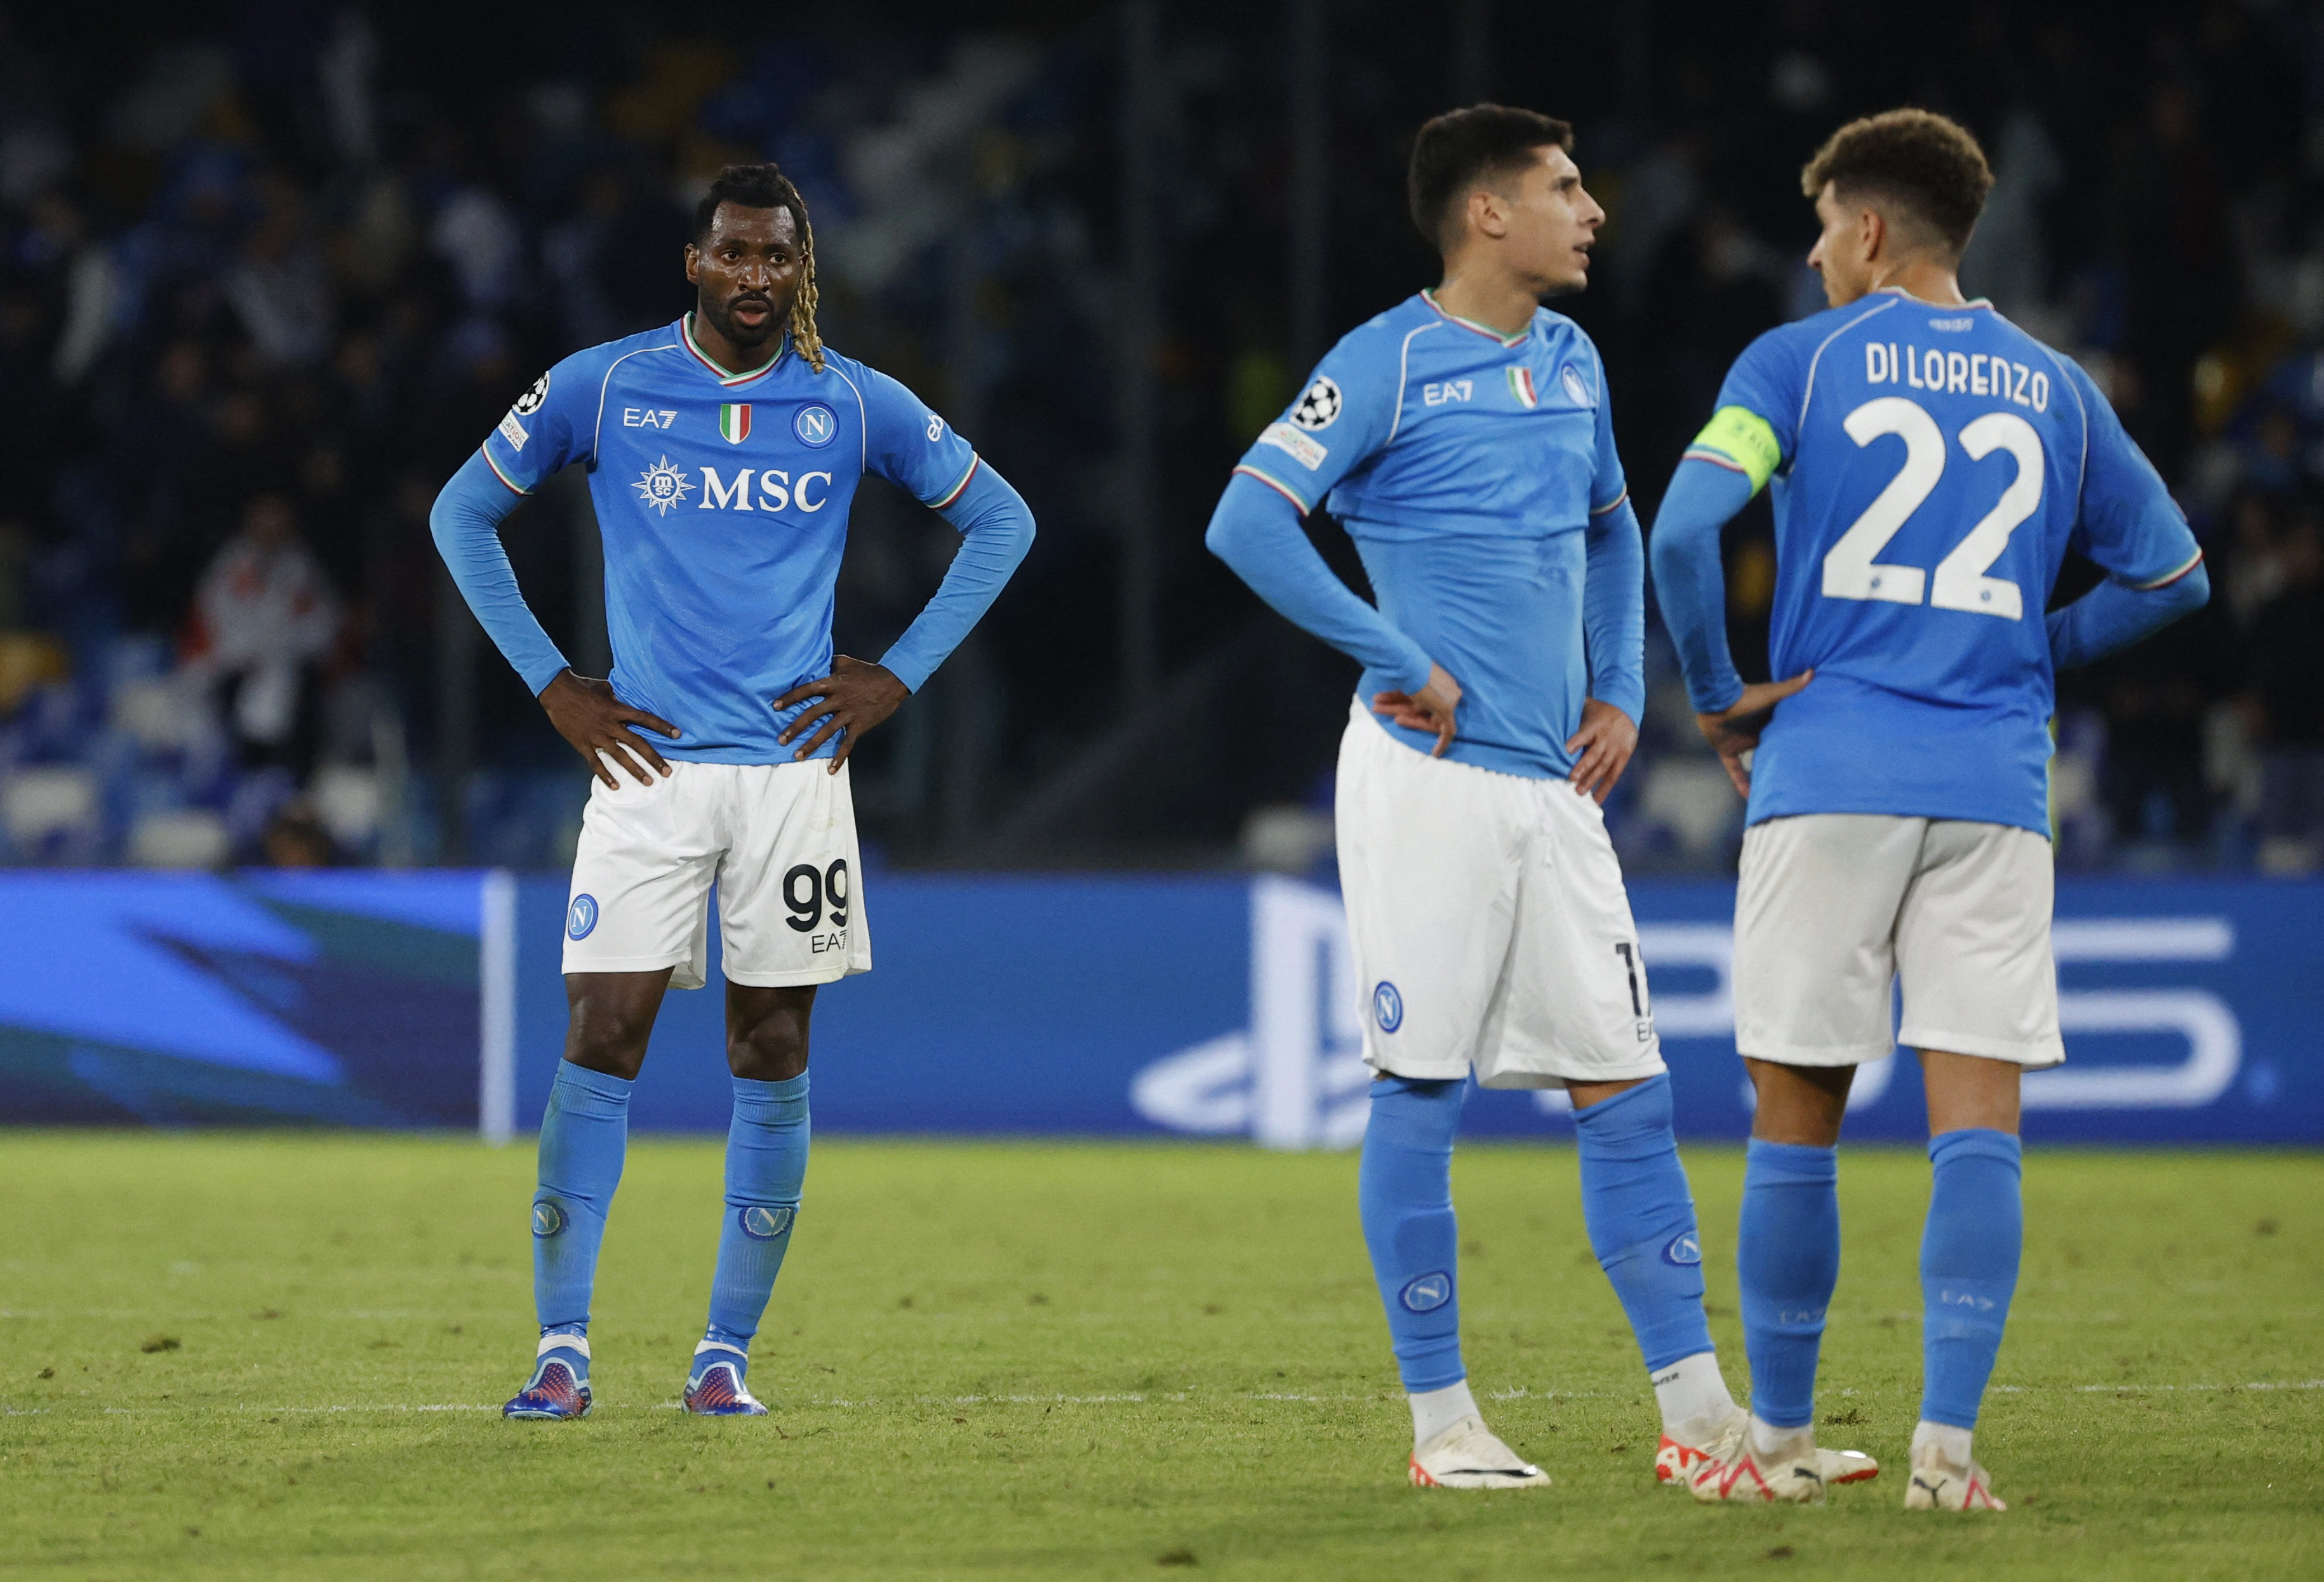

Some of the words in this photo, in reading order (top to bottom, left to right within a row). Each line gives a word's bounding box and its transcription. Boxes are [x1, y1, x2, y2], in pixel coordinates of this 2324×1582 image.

[1423, 380, 1473, 407] EA7
[1865, 342, 1899, 385] DI
[1906, 344, 2050, 413] LORENZO
[620, 407, 678, 429] EA7
[805, 415, 825, 436] N
[698, 467, 832, 512] MSC
[1821, 396, 2045, 622] 22
[782, 858, 849, 933] 99
[571, 905, 588, 927] N
[1615, 943, 1652, 1018] 1
[1378, 994, 1393, 1021] N
